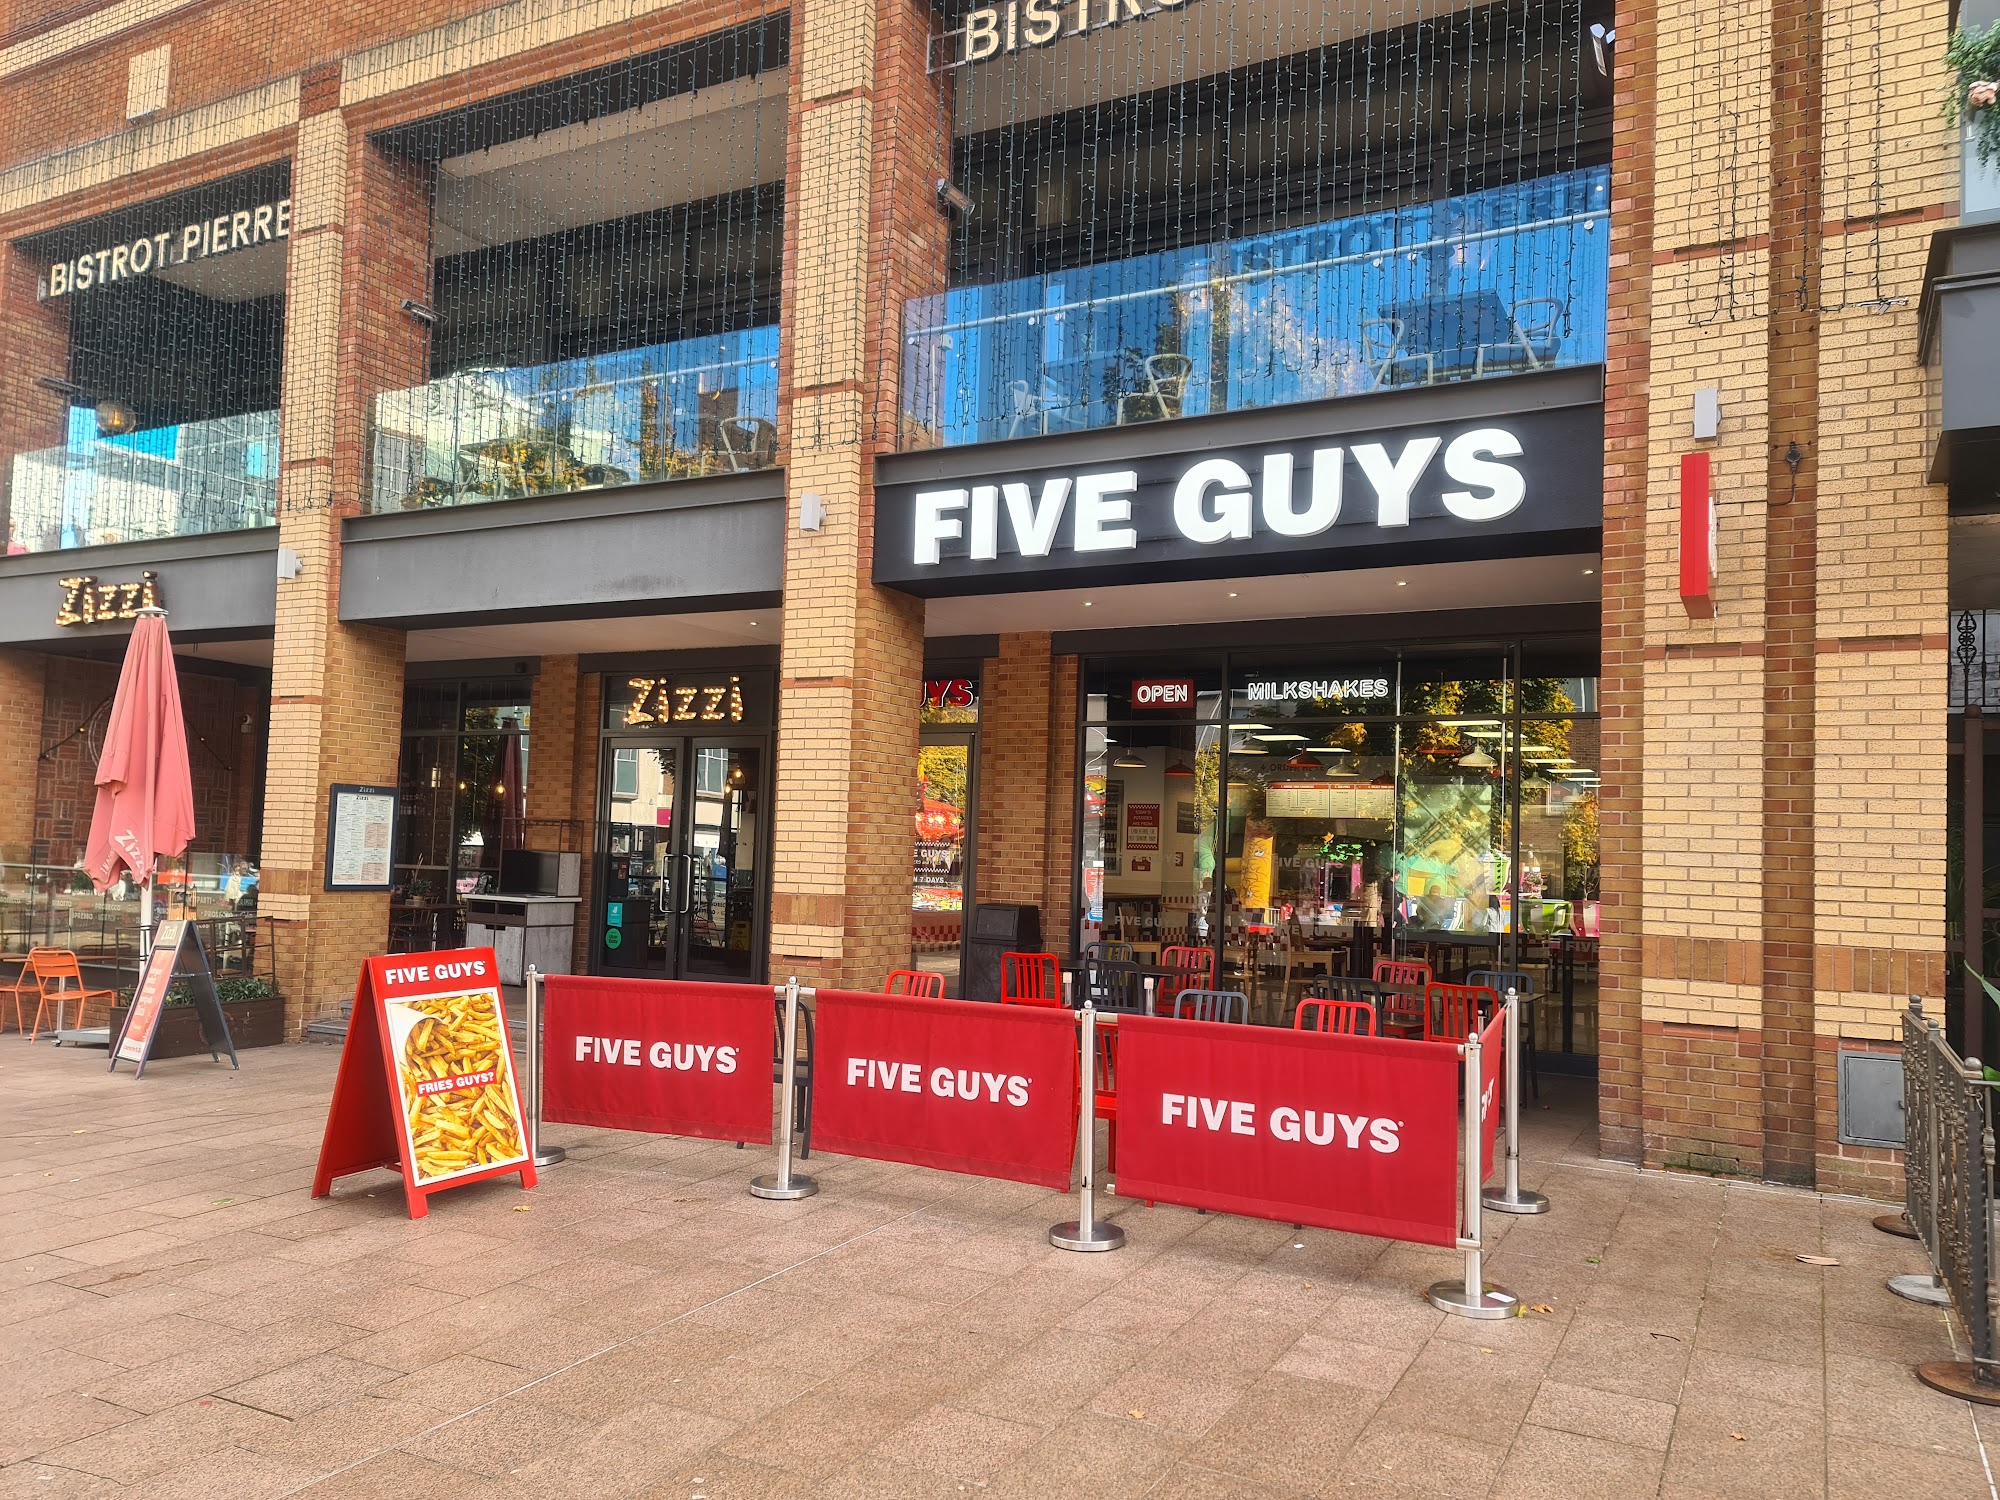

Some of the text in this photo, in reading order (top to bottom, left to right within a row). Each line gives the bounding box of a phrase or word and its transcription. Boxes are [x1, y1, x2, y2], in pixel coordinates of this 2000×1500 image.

[965, 0, 1188, 63] BIST
[50, 199, 290, 297] BISTROT PIERRE
[913, 428, 1527, 566] FIVE GUYS
[56, 571, 158, 627] Zizzi
[624, 676, 743, 725] Zizzi
[921, 679, 974, 708] YS
[1137, 684, 1188, 703] OPEN
[1247, 678, 1388, 701] MILKSHAKES
[385, 961, 486, 985] FIVE GUYS
[575, 1035, 738, 1074] FIVE GUYS
[418, 1072, 494, 1094] FRIES GUYS?
[847, 1057, 1031, 1107] FIVE GUYS
[1162, 1093, 1402, 1154] FIVE GUYS
